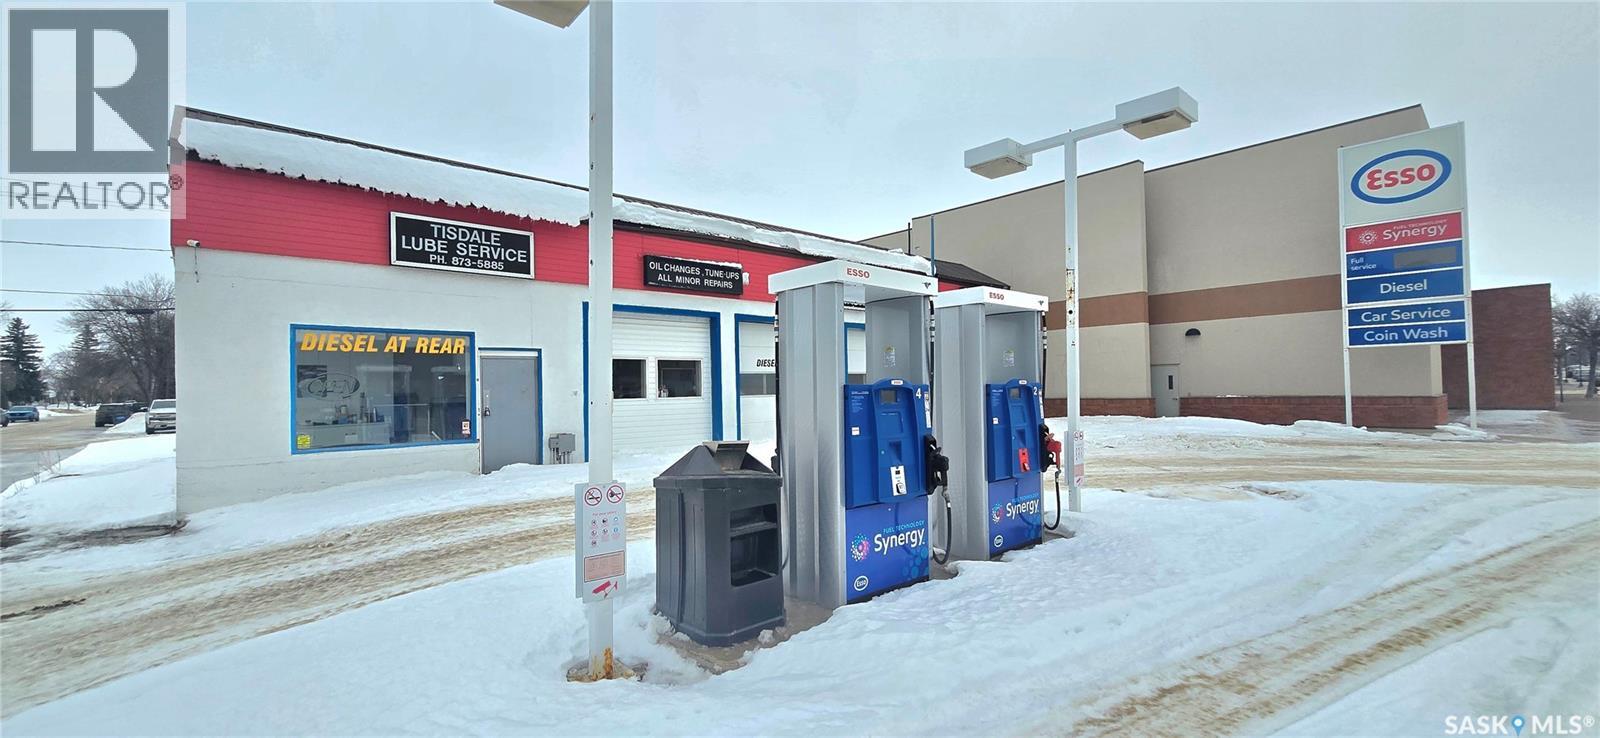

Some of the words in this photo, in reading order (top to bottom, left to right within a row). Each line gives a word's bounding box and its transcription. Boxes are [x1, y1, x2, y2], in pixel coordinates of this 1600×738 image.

[430, 223, 501, 246] TISDALE
[1382, 223, 1448, 241] Synergy
[401, 235, 448, 254] LUBE
[456, 242, 527, 263] SERVICE
[429, 254, 448, 264] PH.
[451, 256, 504, 271] 873-5885
[649, 261, 663, 271] OIL
[1350, 257, 1364, 265] Full
[1351, 263, 1377, 271] service
[846, 267, 870, 279] ESSO
[657, 273, 672, 282] ALL
[675, 276, 701, 285] MINOR
[704, 279, 733, 289] REPAIRS
[1380, 279, 1427, 294] Diesel
[989, 291, 1005, 300] ESSO
[1361, 311, 1387, 322] Car
[1391, 307, 1451, 321] Service
[1363, 329, 1398, 341] Coin
[1402, 326, 1448, 340] Wash
[301, 332, 378, 353] DIESEL
[384, 335, 411, 354] AT
[415, 337, 466, 354] REAR
[915, 387, 922, 399] 4
[1033, 386, 1038, 396] 2
[1006, 498, 1040, 520] Synergy
[896, 520, 925, 531] TECHNOLOGY
[874, 527, 926, 555] Synergy
